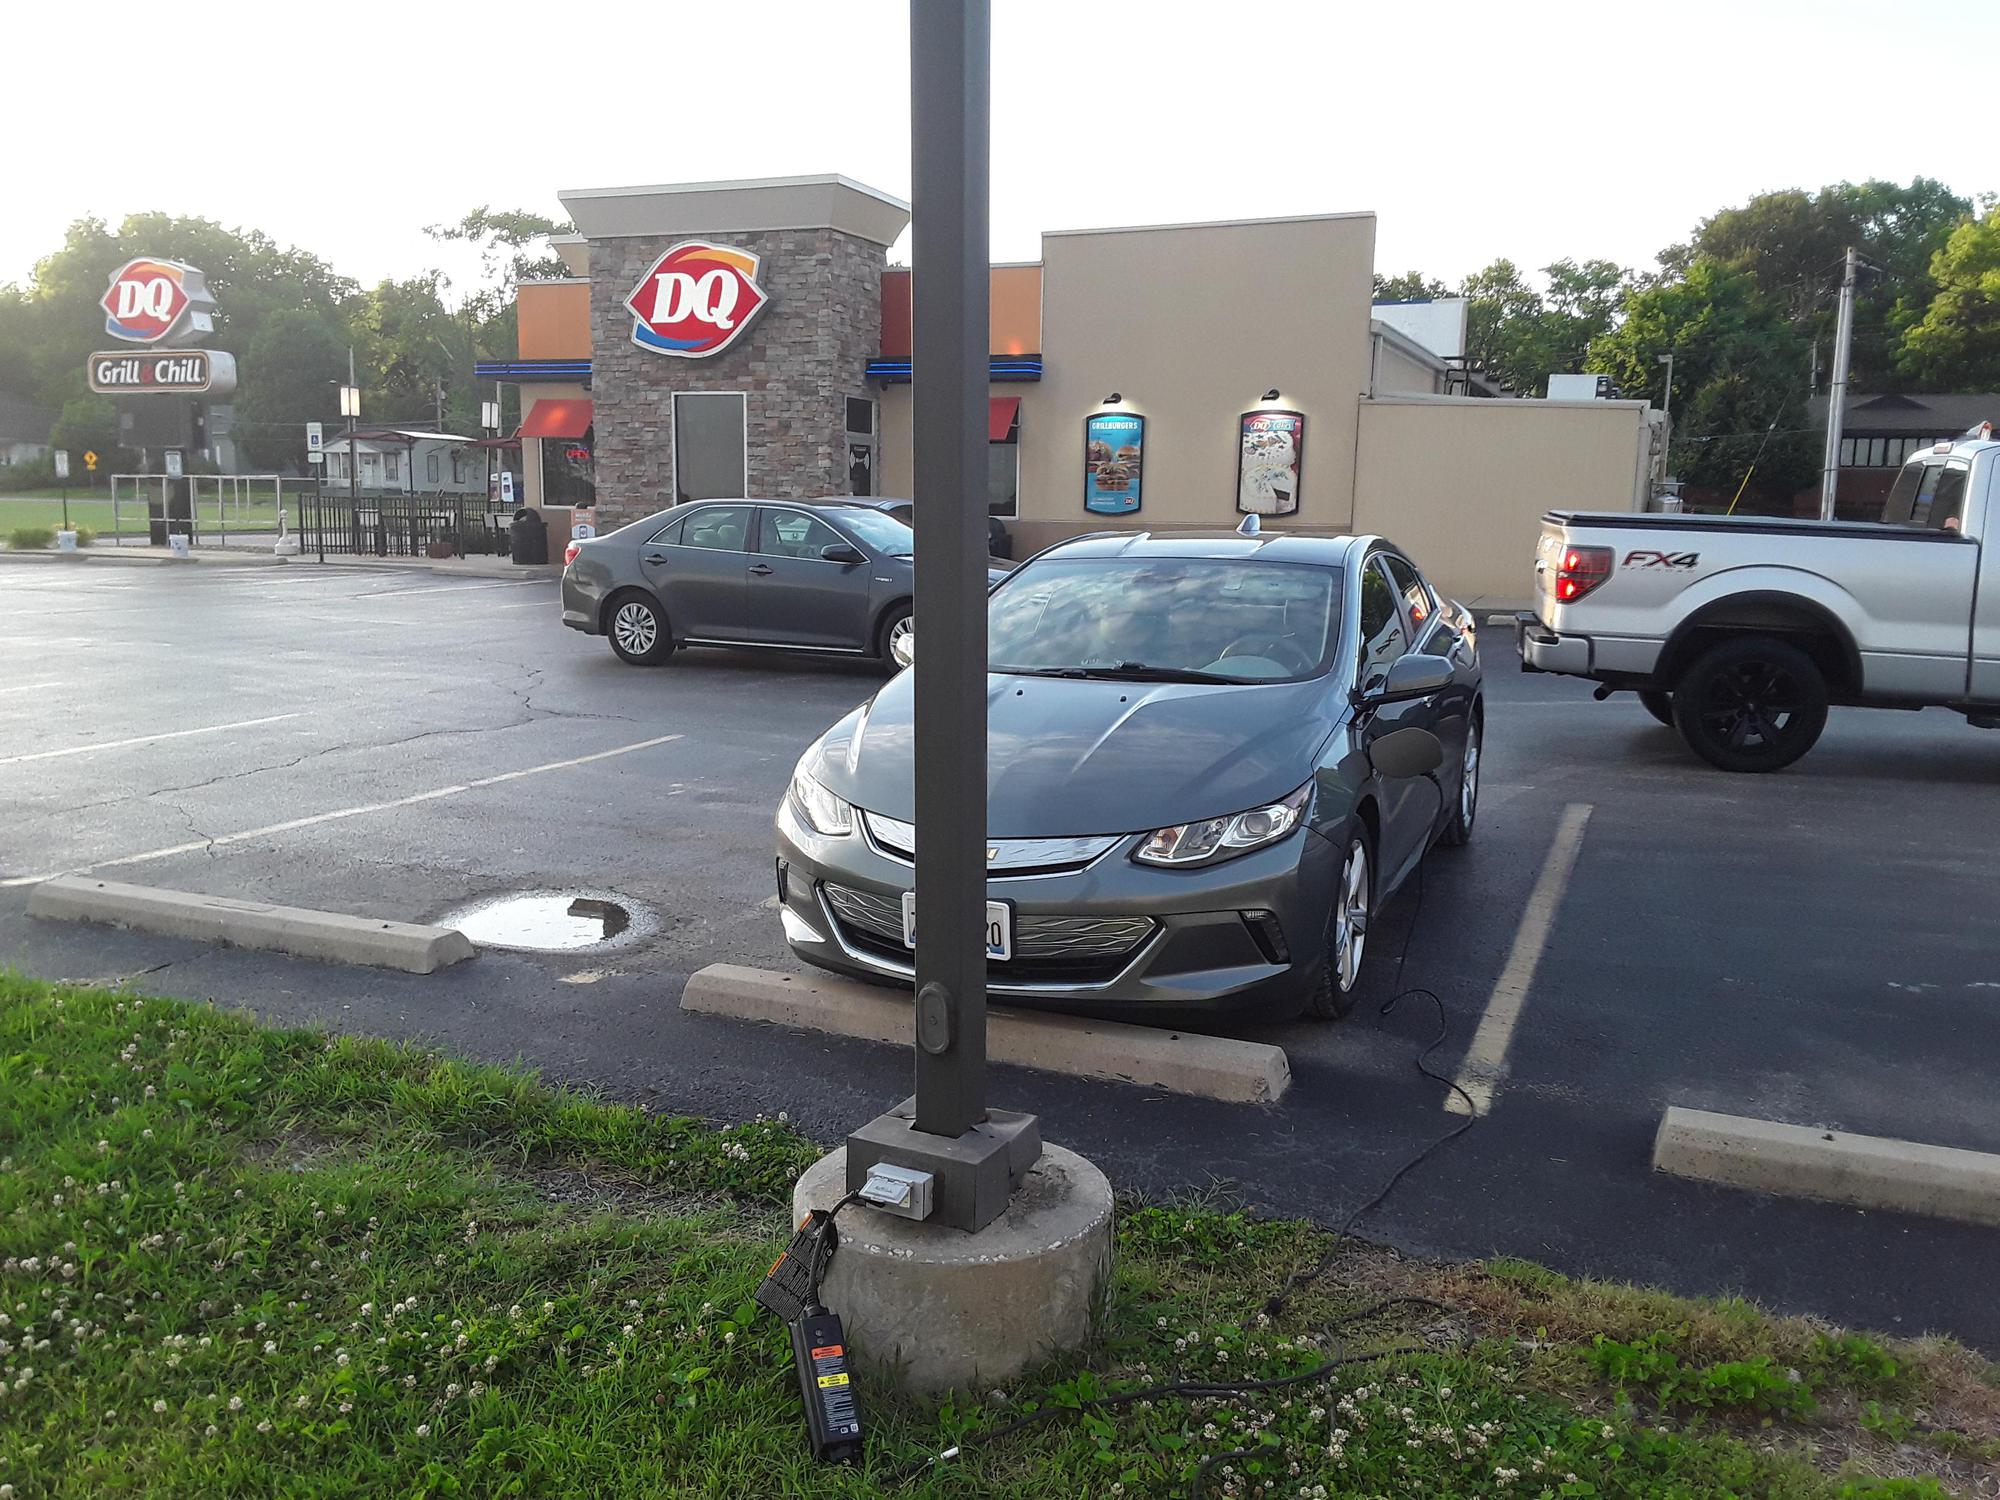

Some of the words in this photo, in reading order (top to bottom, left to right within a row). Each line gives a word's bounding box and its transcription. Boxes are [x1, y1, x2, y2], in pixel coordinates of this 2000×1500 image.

[117, 278, 173, 322] DQ
[650, 269, 739, 329] DQ
[98, 360, 139, 384] Grill
[155, 359, 202, 383] Chill
[1091, 421, 1138, 430] GRILLBURGERS
[1621, 550, 1700, 568] FX4
